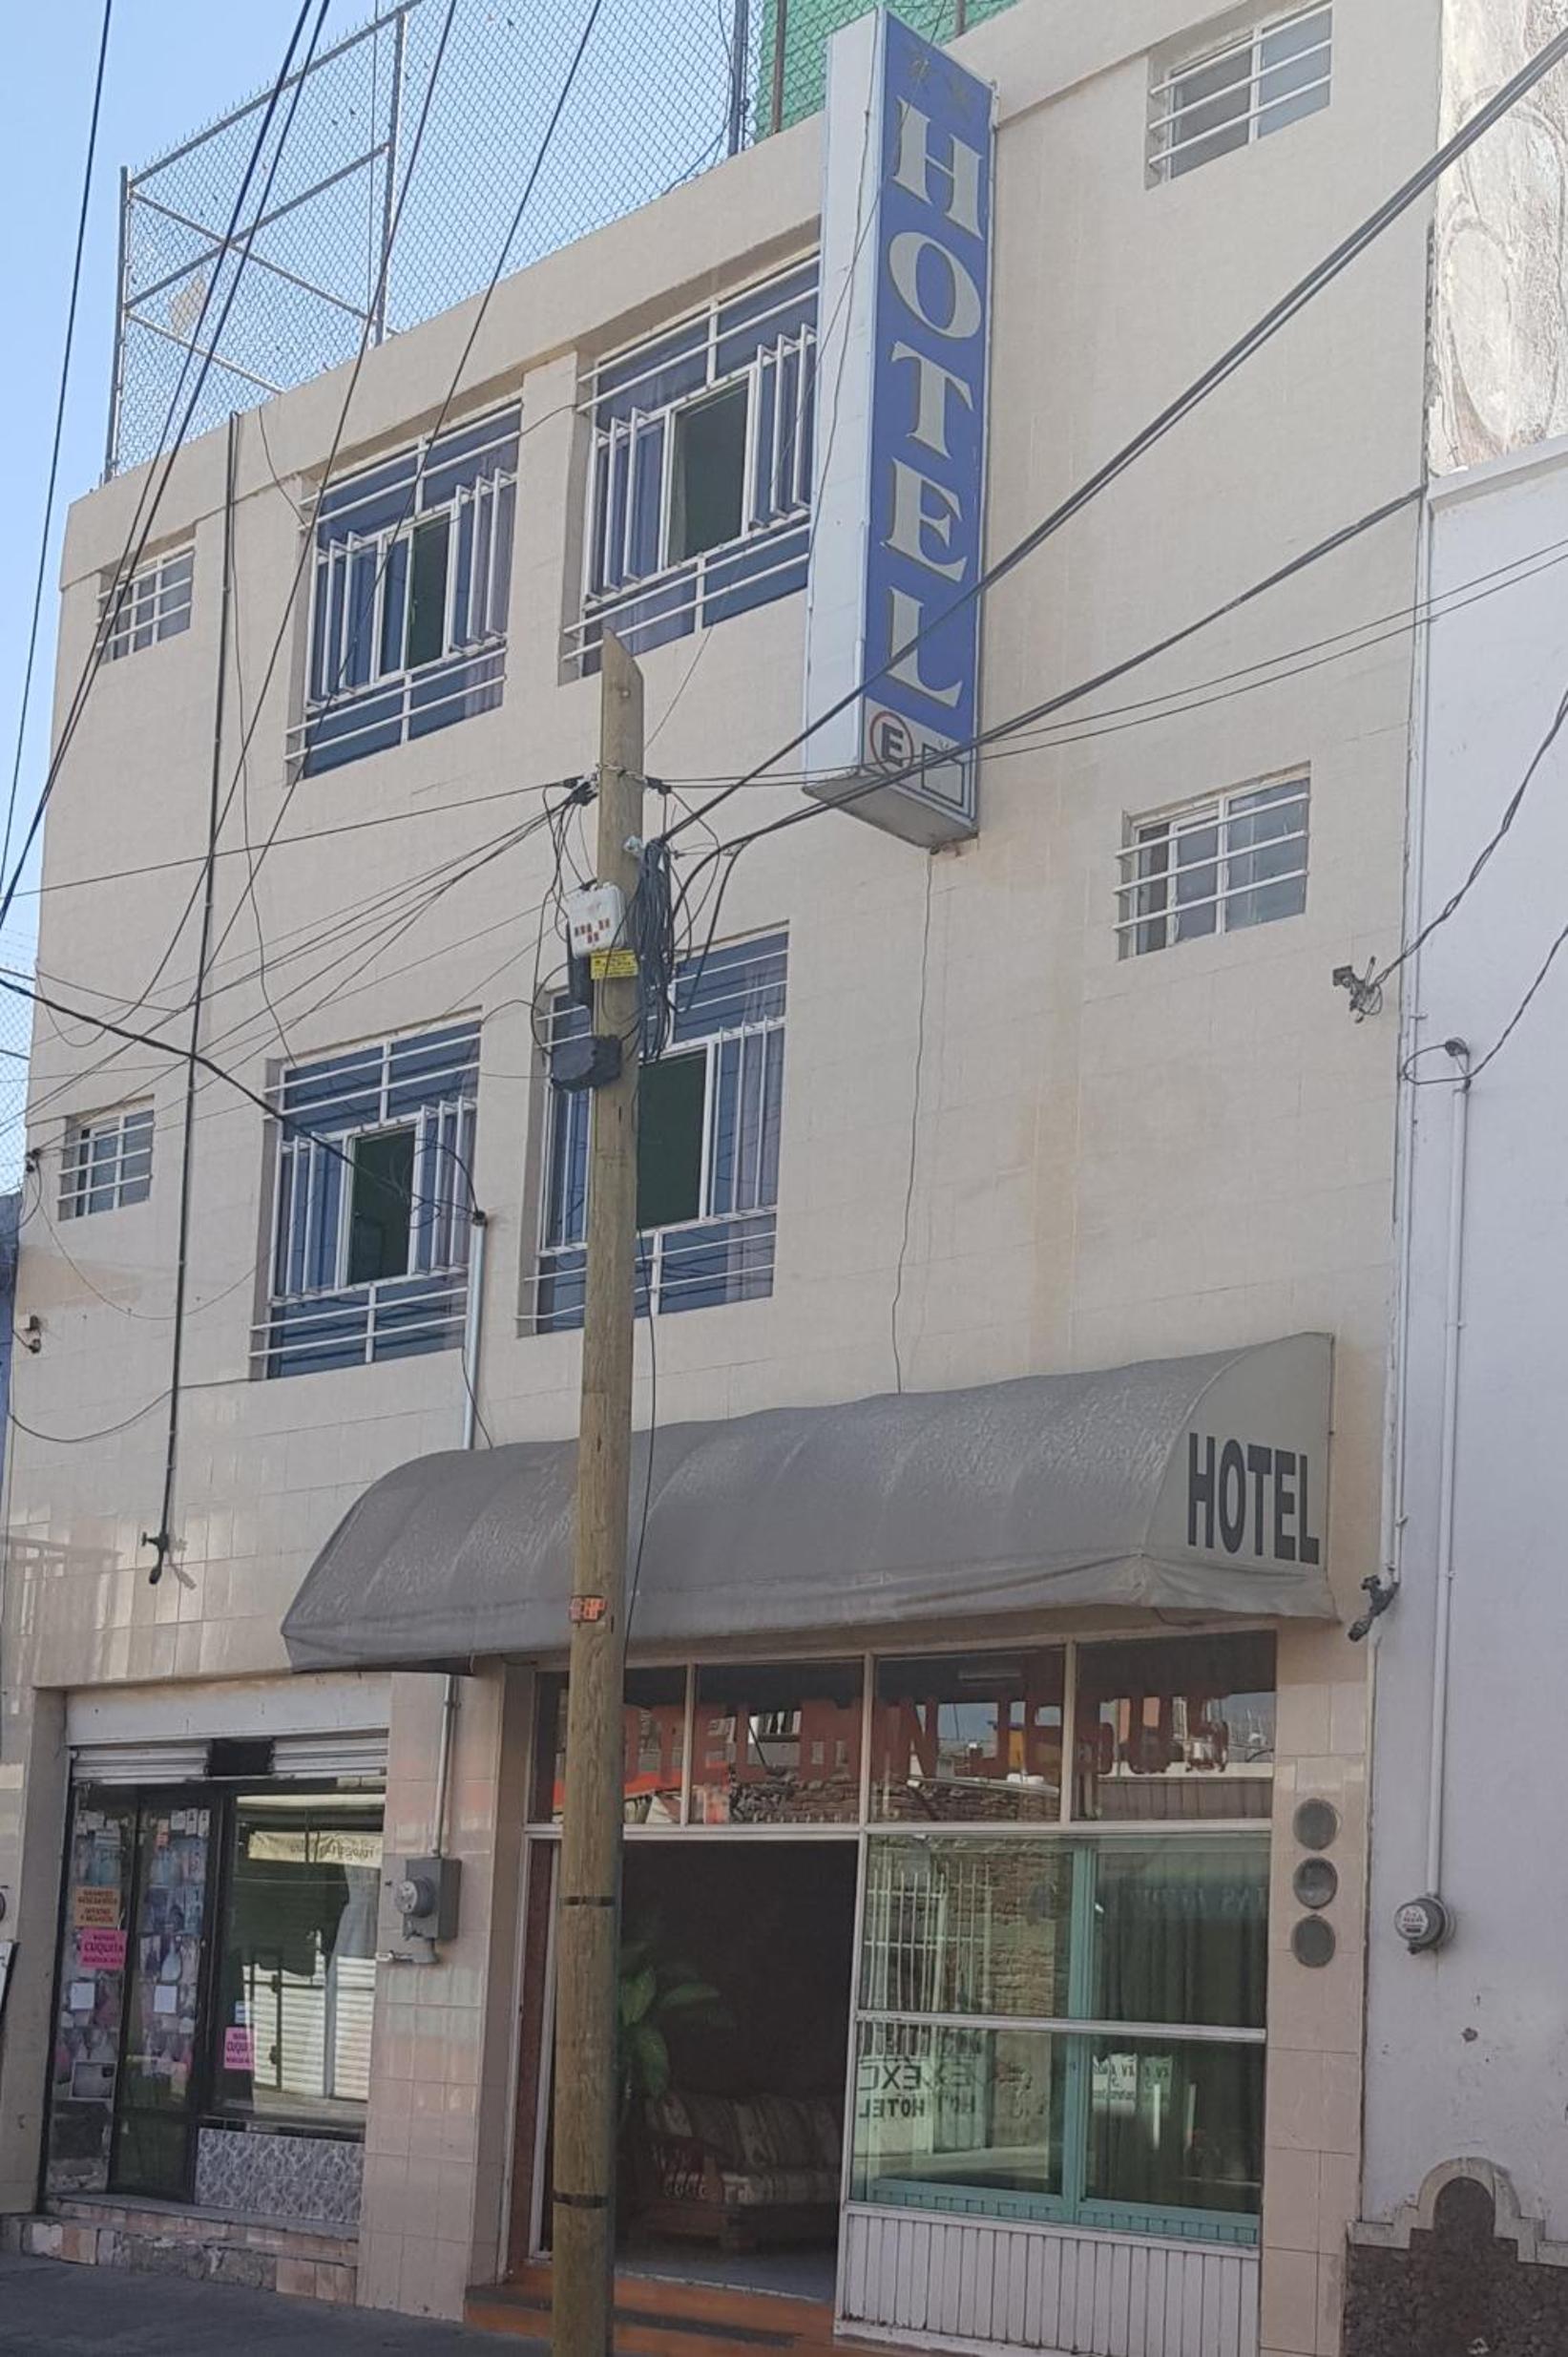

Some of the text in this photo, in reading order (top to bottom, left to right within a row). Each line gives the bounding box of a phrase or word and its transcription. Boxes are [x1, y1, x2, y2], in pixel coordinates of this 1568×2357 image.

[884, 97, 984, 708] HOTEL
[881, 722, 904, 768] E
[1188, 1433, 1320, 1565] HOTEL
